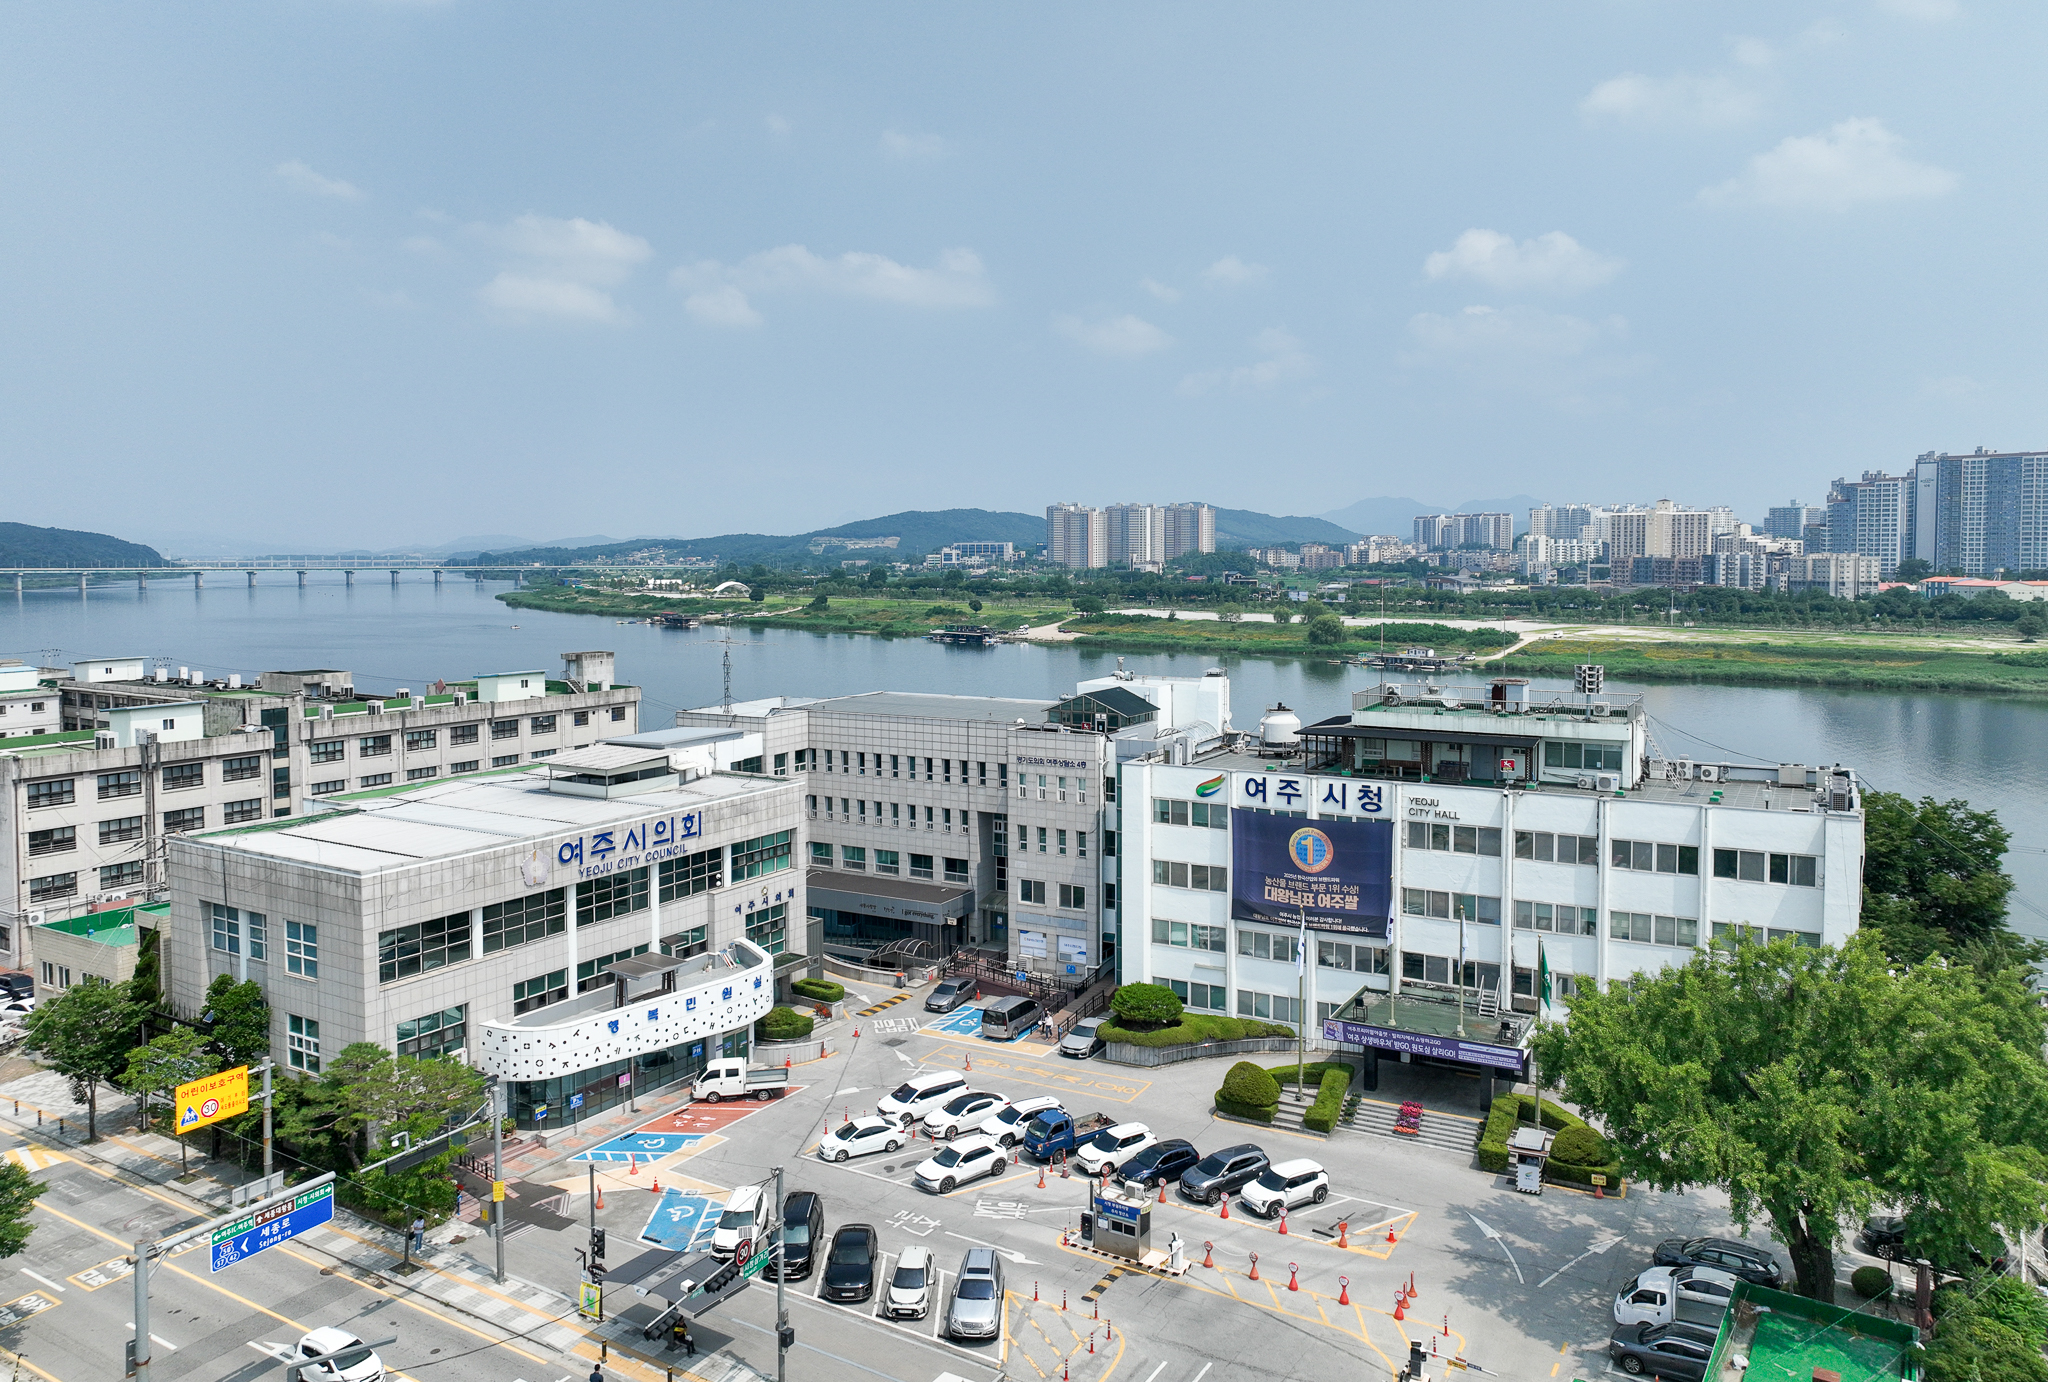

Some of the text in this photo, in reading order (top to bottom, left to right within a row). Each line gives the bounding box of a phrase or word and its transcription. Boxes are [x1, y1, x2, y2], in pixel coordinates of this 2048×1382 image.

[1408, 796, 1439, 807] YEOJU
[1408, 808, 1460, 820] CITY HALL
[558, 810, 702, 865] 여주시의회
[1301, 837, 1313, 864] 1
[578, 844, 688, 878] YEOJU CITY COUNCIL
[1265, 876, 1359, 894] 농산물 브랜드 부문 1위 수상!
[1264, 886, 1359, 910] 대왕님표 여주쌀
[872, 1017, 920, 1034] 진입금지
[181, 1072, 243, 1098] 어린이보호구역
[204, 1102, 216, 1114] 30
[260, 1218, 290, 1237] 세종로
[259, 1230, 292, 1249] Sejong-ro
[740, 1246, 748, 1260] 30
